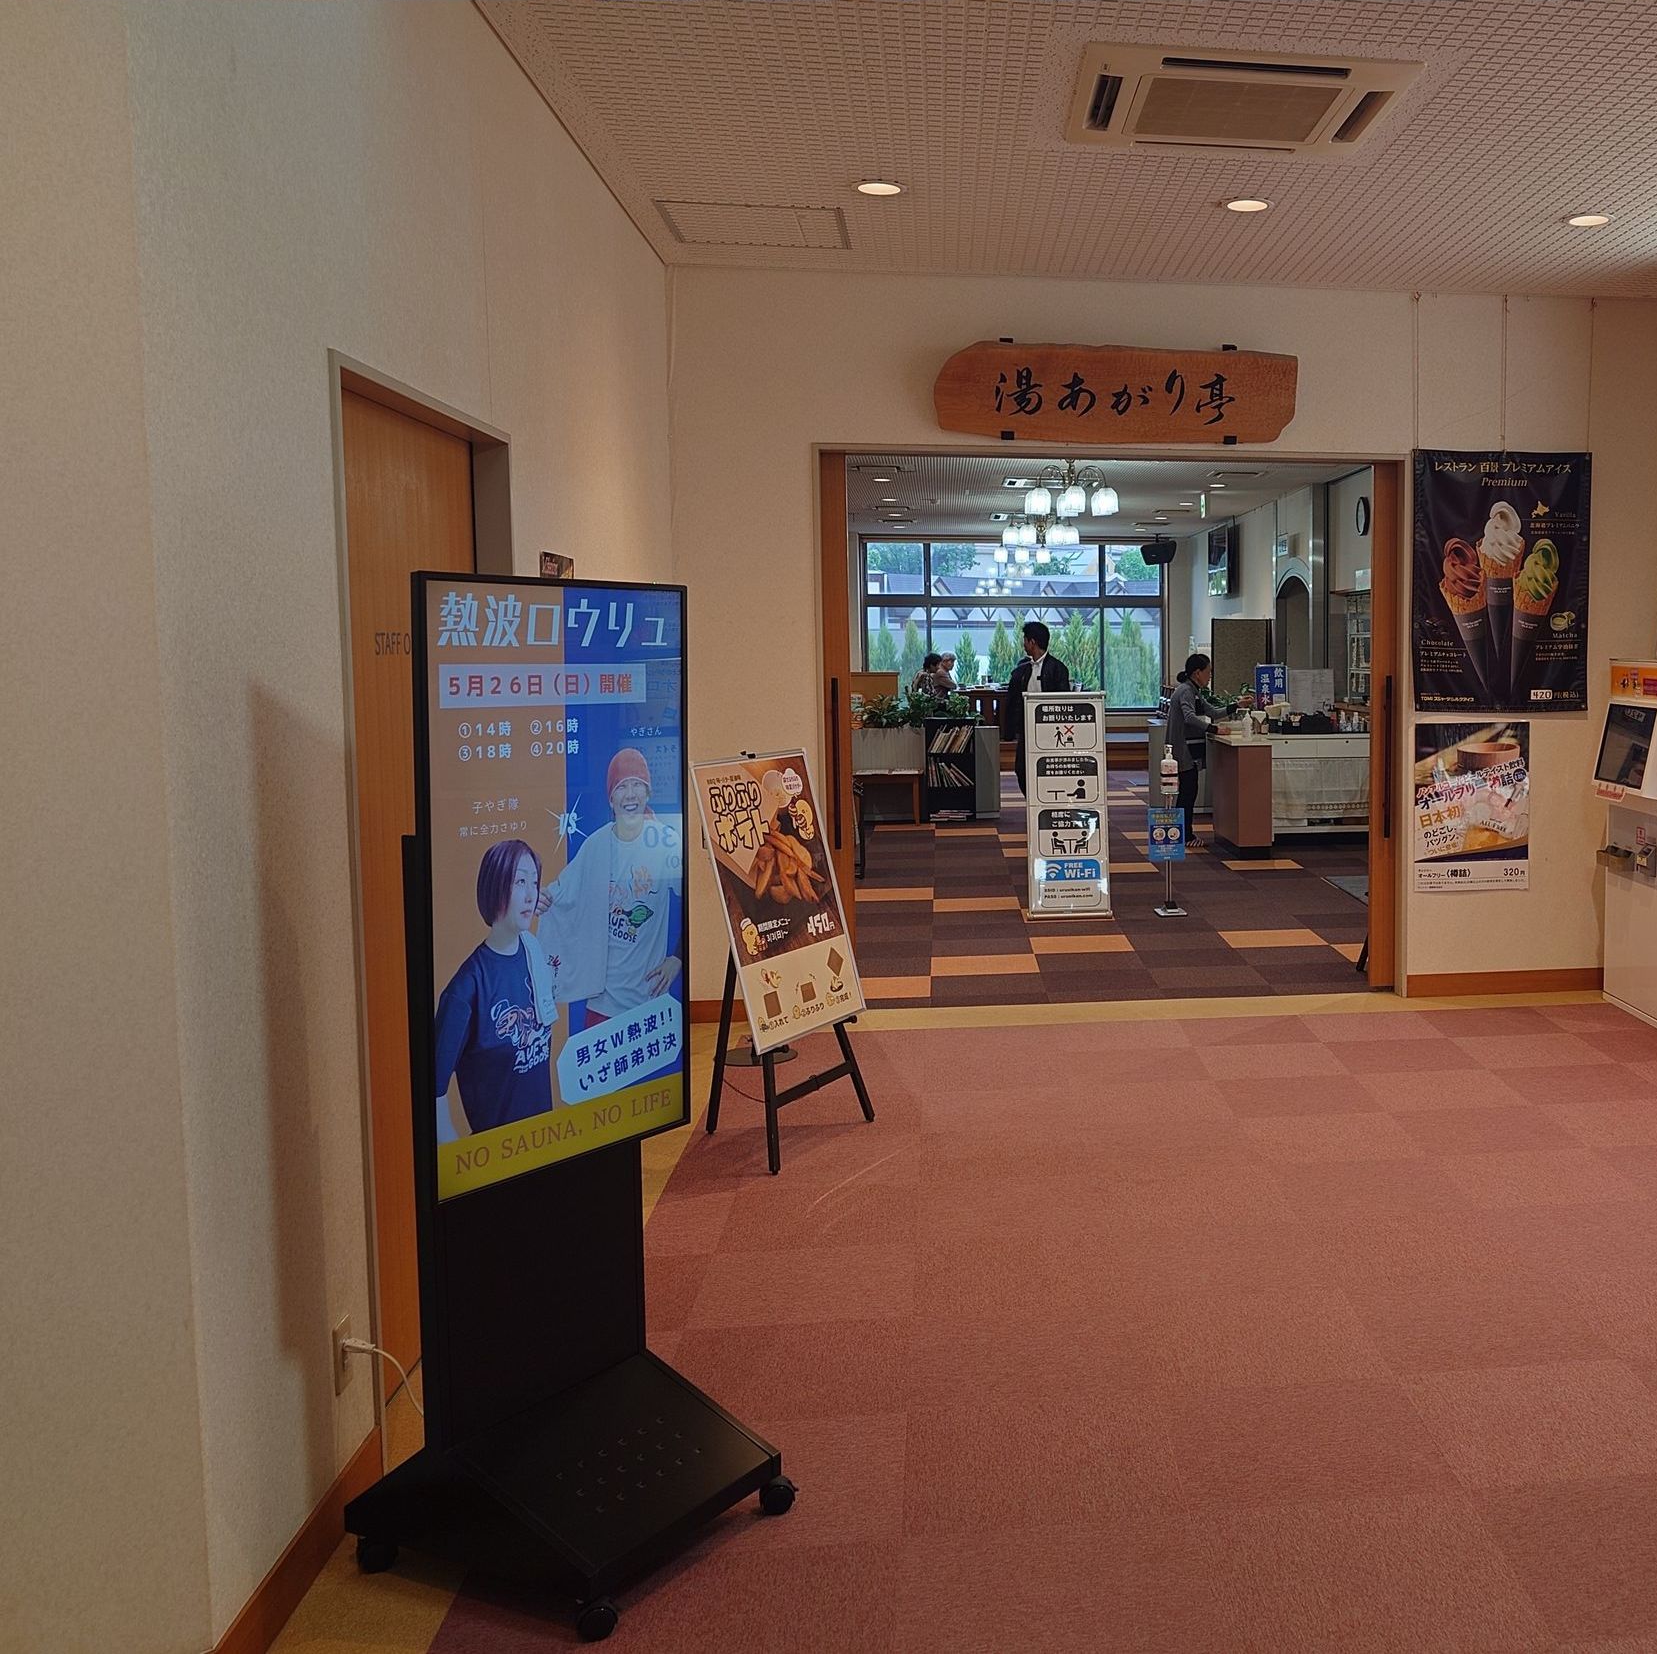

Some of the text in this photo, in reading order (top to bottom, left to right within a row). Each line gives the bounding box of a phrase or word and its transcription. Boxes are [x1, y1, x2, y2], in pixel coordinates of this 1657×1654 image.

[995, 367, 1236, 426] 湯あがり亭
[1434, 461, 1572, 475] レストラン 百景 プレミアムアイス
[1481, 477, 1528, 487] Premium
[437, 591, 668, 648] 熱波ロウリュ
[375, 632, 400, 656] STAFF
[1420, 639, 1454, 647] Chocolate
[1552, 631, 1578, 639] Matcha
[448, 673, 633, 697] 5月26日（日）開催
[1260, 673, 1271, 705] 温泉水
[1273, 667, 1285, 689] 飲用
[458, 718, 579, 739] ①14時 ②16時
[630, 727, 662, 737] やぎさん
[458, 739, 580, 762] ③18時 ④20時
[471, 797, 520, 815] 子やぎ隊
[709, 780, 763, 814] ふりふり
[1419, 805, 1461, 828] 日本初
[458, 820, 528, 838] 常に全力さゆり
[714, 807, 771, 855] ポテト
[1064, 868, 1096, 878] Wi-Fi
[1503, 867, 1525, 877] 320円
[576, 1007, 674, 1068] 男女W熱波!!
[579, 1032, 678, 1092] いざ師弟対決
[455, 1088, 672, 1175] NO SAUNA, NO LIFE
